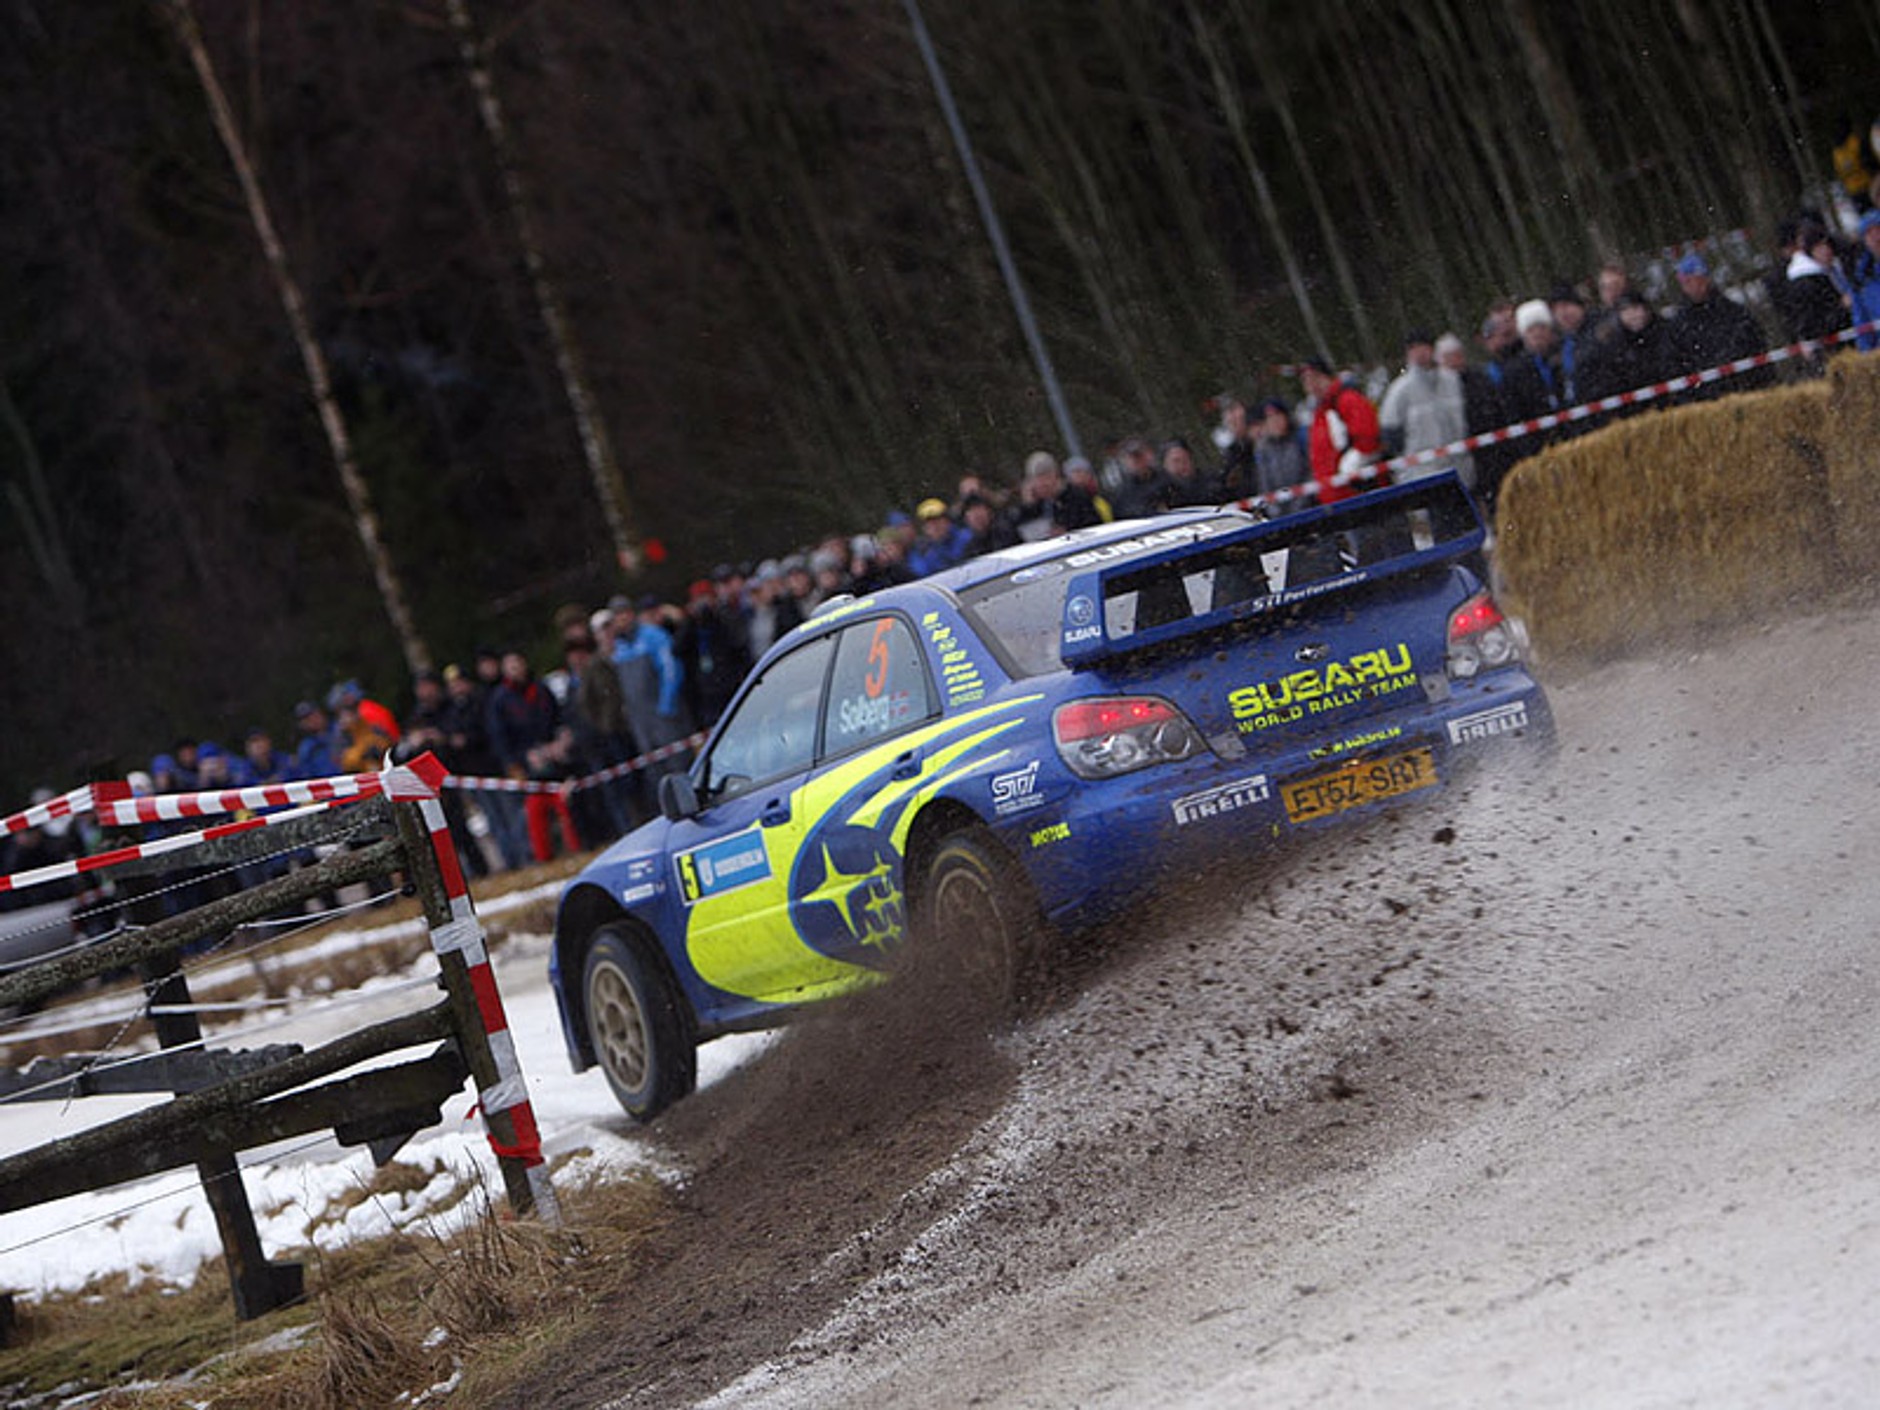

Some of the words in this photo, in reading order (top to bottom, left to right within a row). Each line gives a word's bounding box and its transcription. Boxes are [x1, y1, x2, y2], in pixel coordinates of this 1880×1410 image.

[1066, 523, 1214, 568] SUBARU
[865, 616, 897, 699] 5
[1063, 624, 1102, 644] SUBARU
[1228, 643, 1413, 719] SUBARU
[1237, 704, 1304, 734] WORLD
[1307, 687, 1363, 715] RALLY
[1369, 672, 1418, 698] TEAM
[840, 693, 892, 735] Solberg
[1446, 700, 1529, 746] PIRELLI
[1369, 755, 1422, 793] SRT
[1172, 773, 1271, 825] PIRELLI
[678, 852, 701, 901] 5
